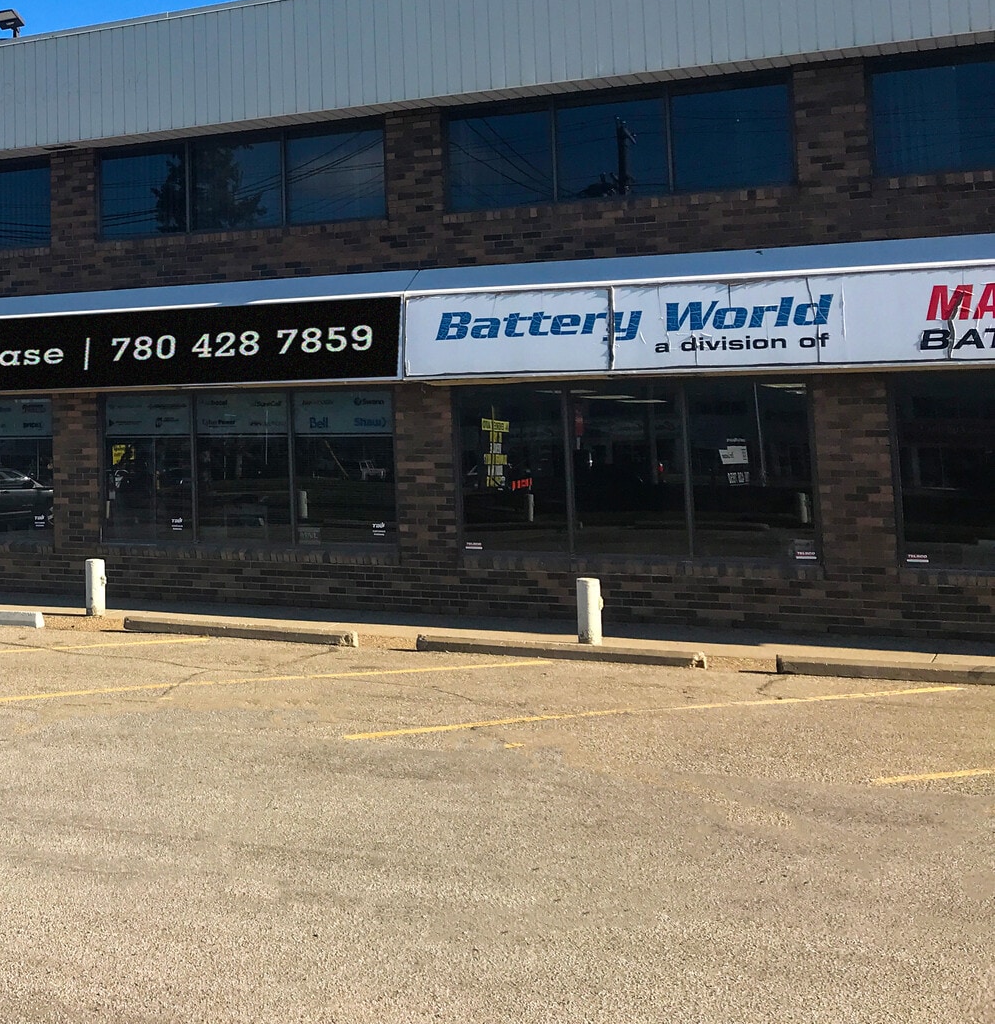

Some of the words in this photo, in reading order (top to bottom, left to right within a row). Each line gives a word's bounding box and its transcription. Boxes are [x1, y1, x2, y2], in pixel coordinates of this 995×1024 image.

[435, 310, 643, 342] Battery
[665, 293, 834, 332] World
[926, 283, 995, 321] MA
[111, 334, 177, 362] 780
[191, 330, 260, 358] 428
[276, 324, 374, 355] 7859
[654, 342, 670, 354] a
[680, 335, 787, 352] division
[799, 332, 830, 349] of
[309, 416, 329, 429] Bell
